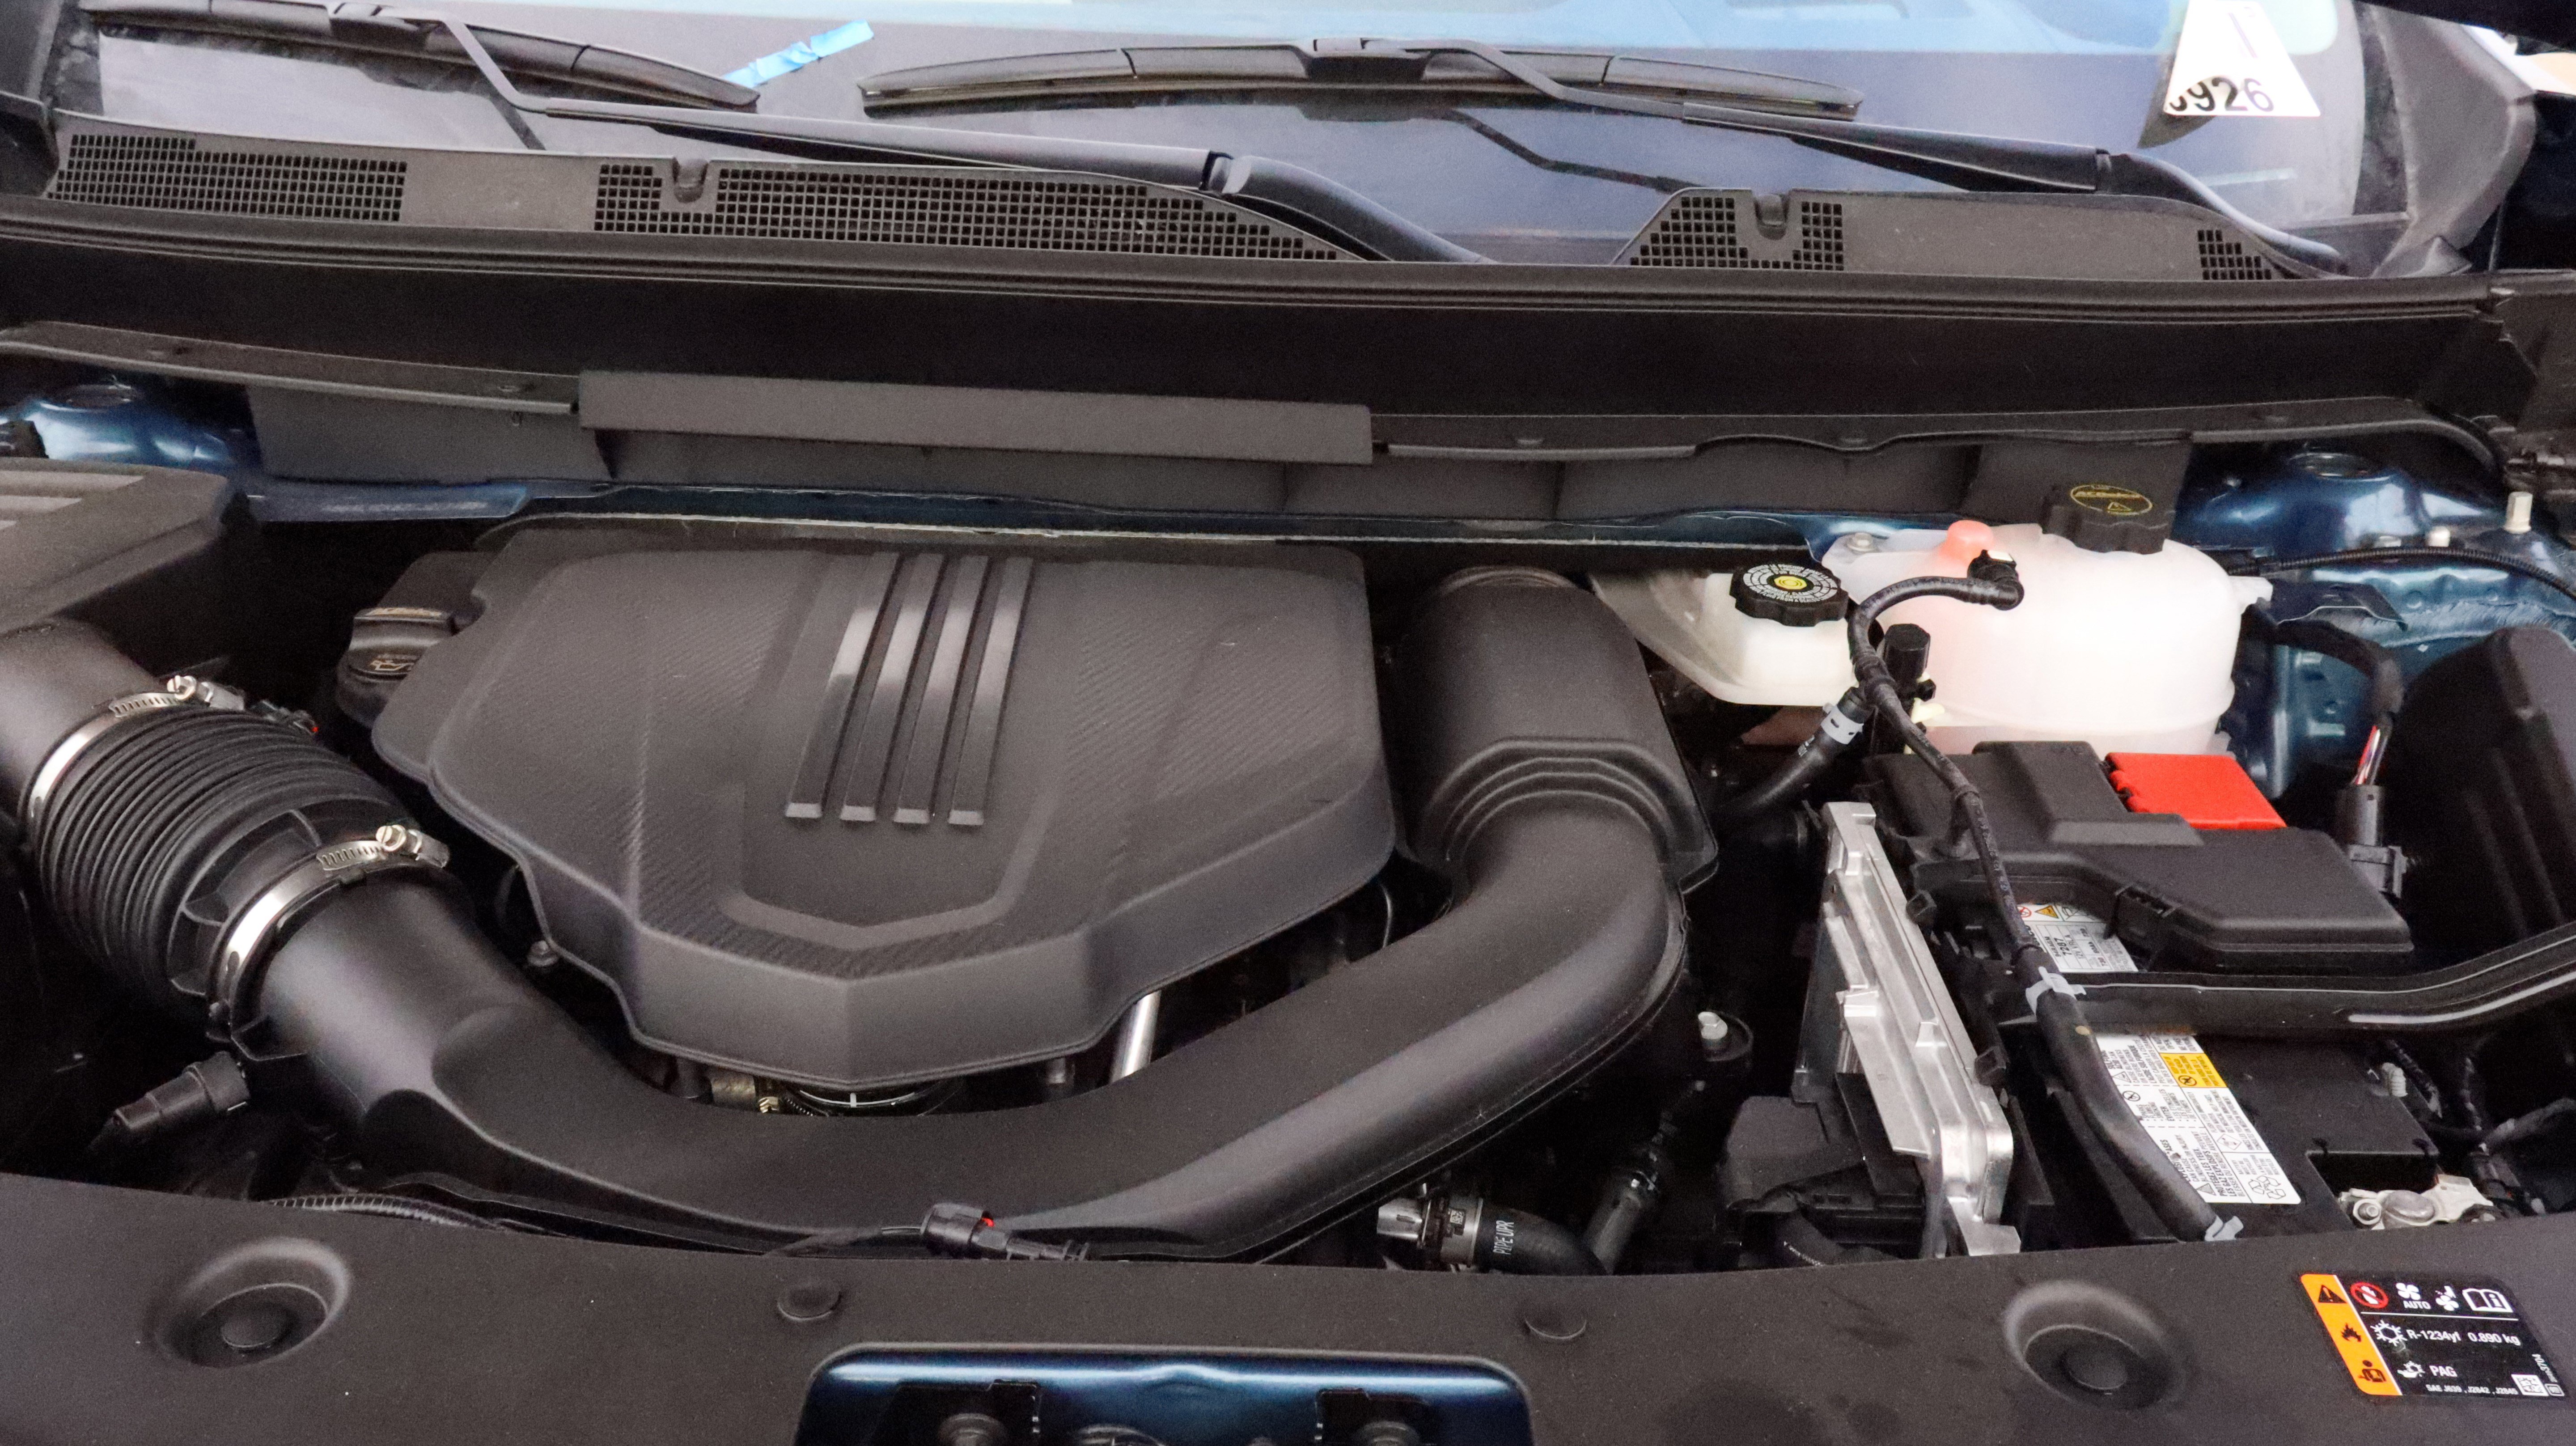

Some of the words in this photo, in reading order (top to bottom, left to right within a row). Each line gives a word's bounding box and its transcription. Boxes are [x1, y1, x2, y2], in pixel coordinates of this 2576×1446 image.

[2053, 937, 2073, 955] 7287
[2063, 934, 2078, 948] VRLA
[2072, 950, 2085, 959] 12V
[2199, 1162, 2212, 1170] LES
[2202, 1150, 2224, 1175] EXPLOSIFS
[2224, 1187, 2237, 1196] LES
[1496, 1221, 1514, 1236] UPR
[1493, 1236, 1513, 1255] PIPE
[2403, 1300, 2432, 1310] AUTO
[2406, 1329, 2462, 1343] R-1234yf
[2467, 1332, 2503, 1343] 0.890
[2502, 1334, 2521, 1346] kg
[2429, 1365, 2458, 1377] PAG
[2426, 1384, 2443, 1392] SAE
